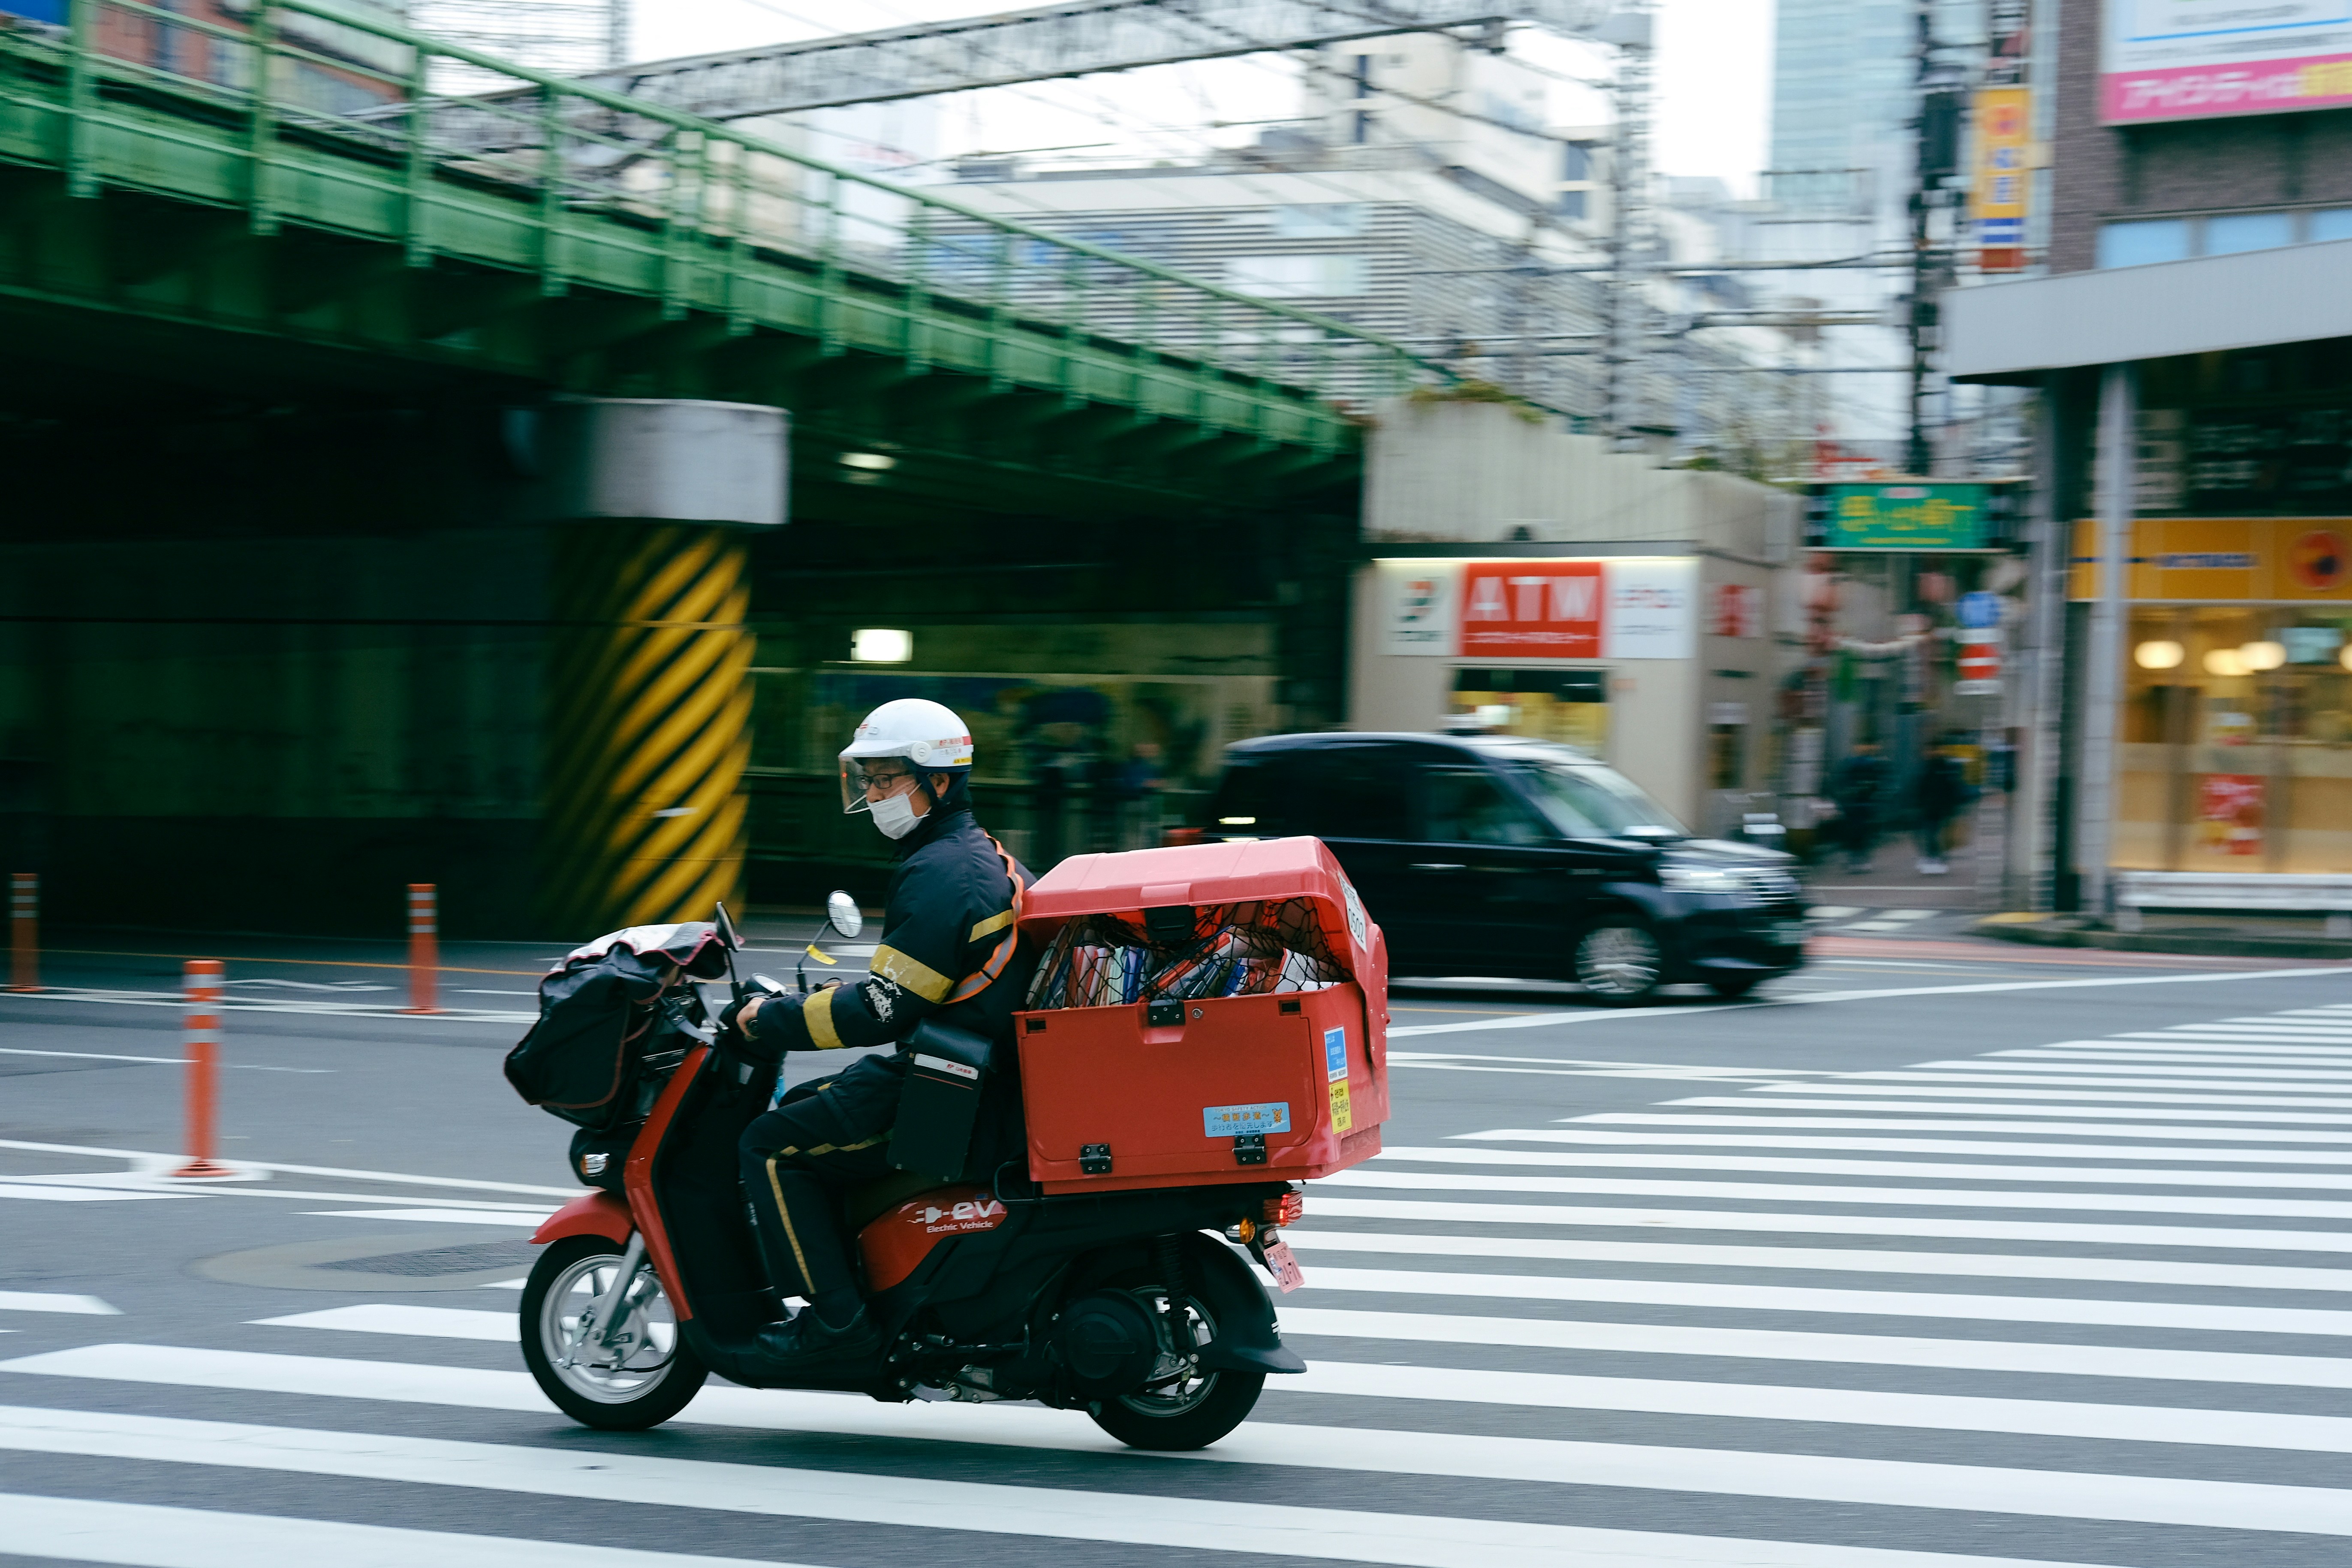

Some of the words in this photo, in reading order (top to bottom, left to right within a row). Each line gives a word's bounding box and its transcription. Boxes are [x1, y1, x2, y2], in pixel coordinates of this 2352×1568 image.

[1461, 576, 1598, 621] ATM
[927, 1223, 958, 1233] Electric
[960, 1221, 994, 1230] Vehicle
